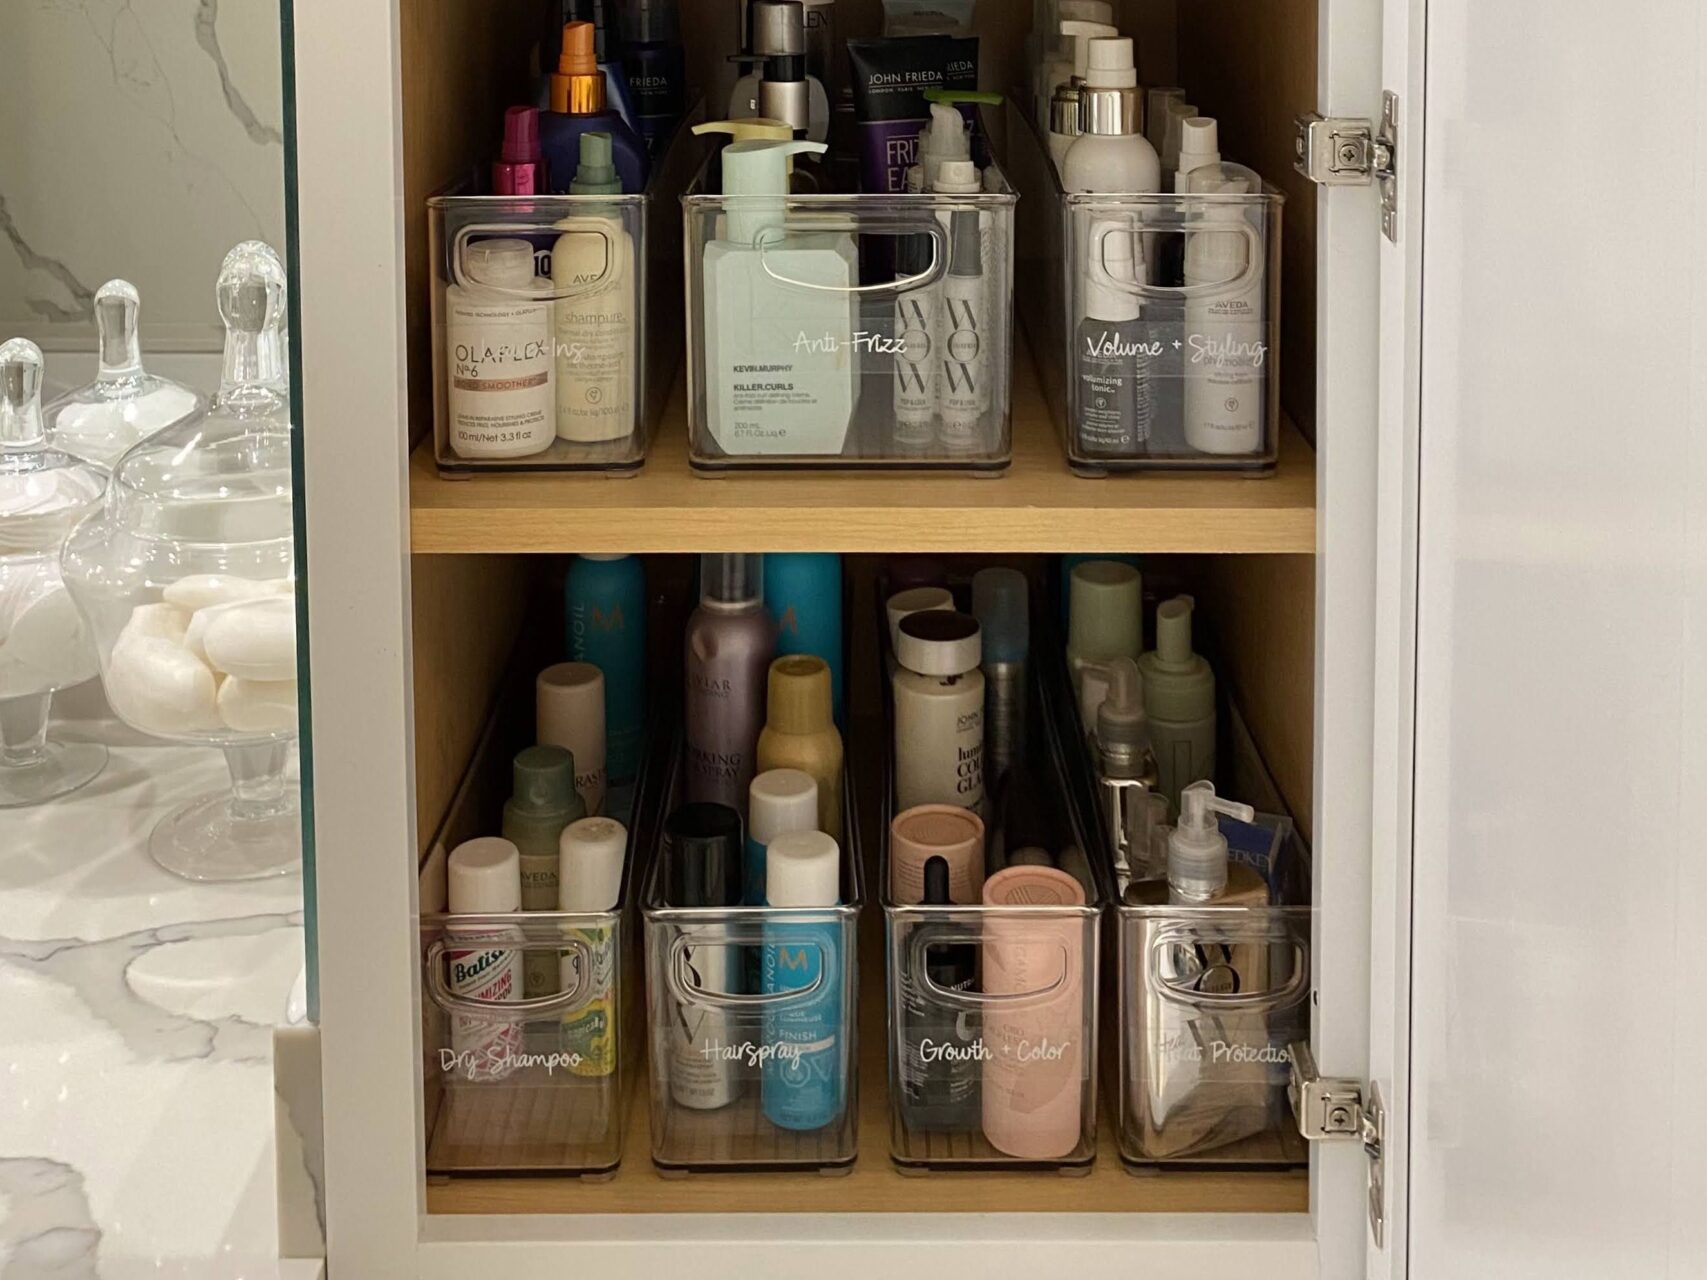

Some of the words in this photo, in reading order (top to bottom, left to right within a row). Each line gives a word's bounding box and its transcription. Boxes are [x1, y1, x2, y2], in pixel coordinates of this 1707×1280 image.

[629, 77, 668, 87] FRIEDA
[868, 73, 900, 84] JOHN
[905, 71, 943, 82] FRIEDA
[792, 330, 907, 354] Anti-Frizz
[1086, 331, 1163, 357] Volume
[1172, 339, 1182, 351] +
[1188, 333, 1268, 368] Styling
[733, 383, 794, 391] KILLER.CURLS
[1081, 374, 1123, 387] volumizing
[951, 977, 976, 991] NUTR
[779, 1029, 817, 1041] FINISH
[700, 1038, 802, 1070] Hairspray
[920, 1038, 993, 1062] Growth
[1002, 1044, 1011, 1055] +
[1017, 1038, 1071, 1062] Color
[438, 1048, 479, 1080] Dry
[487, 1046, 583, 1076] Shampoo
